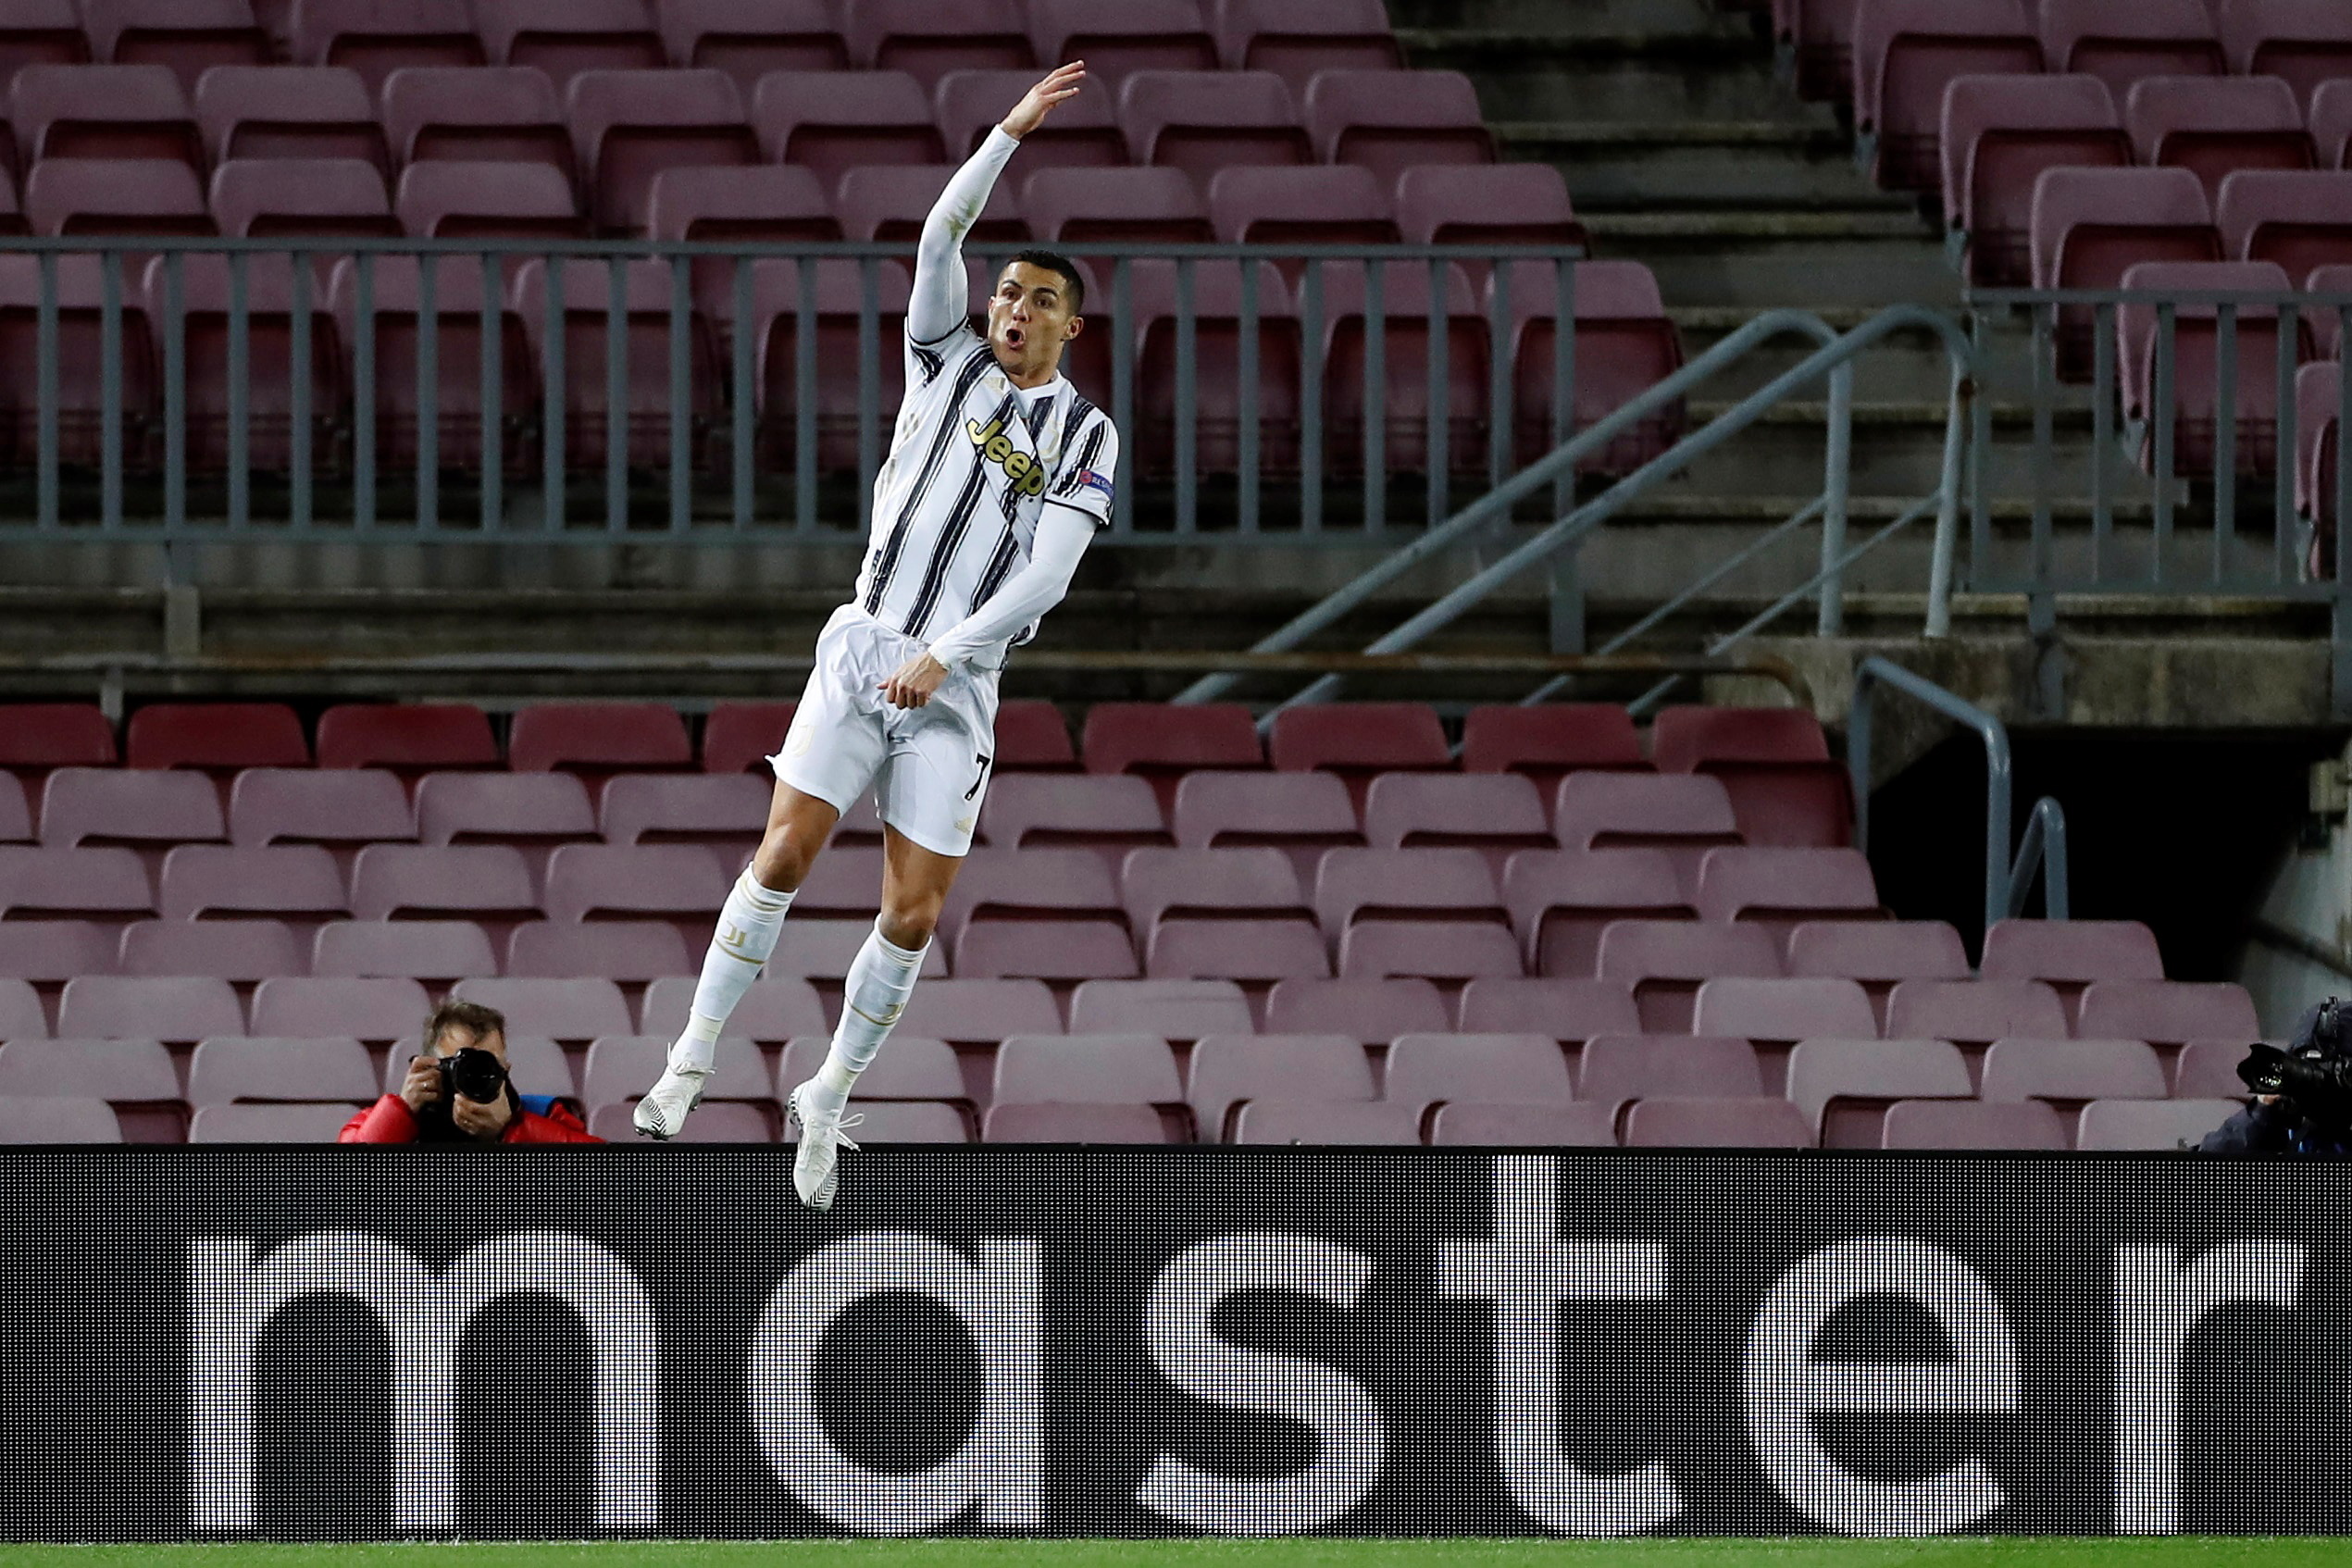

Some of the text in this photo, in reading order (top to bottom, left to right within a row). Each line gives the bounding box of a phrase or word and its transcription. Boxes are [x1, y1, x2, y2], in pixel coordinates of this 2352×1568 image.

[966, 417, 1045, 497] Jeep
[964, 753, 991, 802] 7
[187, 1154, 2308, 1537] master
